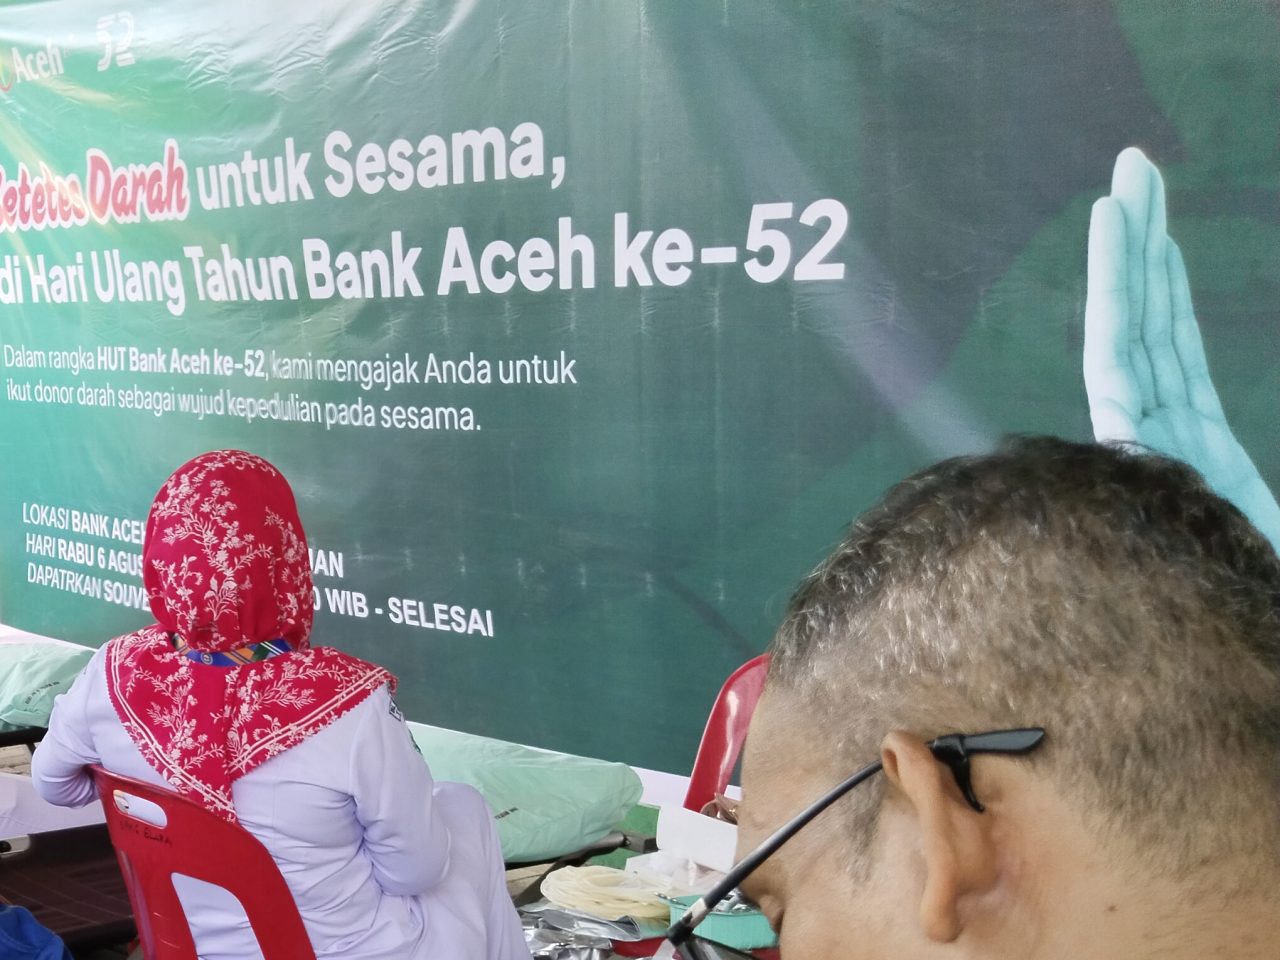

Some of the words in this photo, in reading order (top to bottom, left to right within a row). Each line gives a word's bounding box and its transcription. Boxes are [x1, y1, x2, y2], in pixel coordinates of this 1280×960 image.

[11, 38, 64, 83] Aceh
[96, 11, 135, 71] 52
[87, 139, 190, 224] Darah
[196, 137, 314, 210] untuk
[323, 122, 565, 198] Sesama,
[27, 254, 88, 304] Hari
[94, 248, 185, 315] Ulang
[184, 245, 299, 302] Tahun
[302, 230, 423, 300] Bank
[437, 216, 595, 296] Aceh
[614, 198, 849, 287] ke-52
[4, 344, 46, 369] Dalam
[48, 347, 95, 375] rangka
[97, 347, 127, 371] HUT
[129, 348, 167, 373] Bank
[170, 349, 210, 375] Aceh
[213, 349, 269, 380] ke-52,
[271, 351, 313, 380] kami
[316, 351, 420, 391] mengajak
[424, 352, 492, 384] Anda
[498, 350, 577, 385] untuk
[6, 379, 32, 401] ikut
[34, 380, 74, 404] donor
[77, 382, 116, 407] darah
[117, 386, 176, 416] sebagai
[178, 389, 224, 419] wujud
[226, 390, 322, 428] kepedulian
[325, 397, 377, 432] pada
[380, 402, 482, 431] sesama.
[22, 502, 69, 529] LOKASI
[71, 509, 109, 538] BANK
[26, 532, 56, 558] HARI
[58, 538, 94, 567] RABU
[97, 547, 106, 569] 6
[325, 587, 369, 618] WIB
[388, 597, 494, 637] SELESAI
[27, 562, 101, 599] DAPATRKAN
